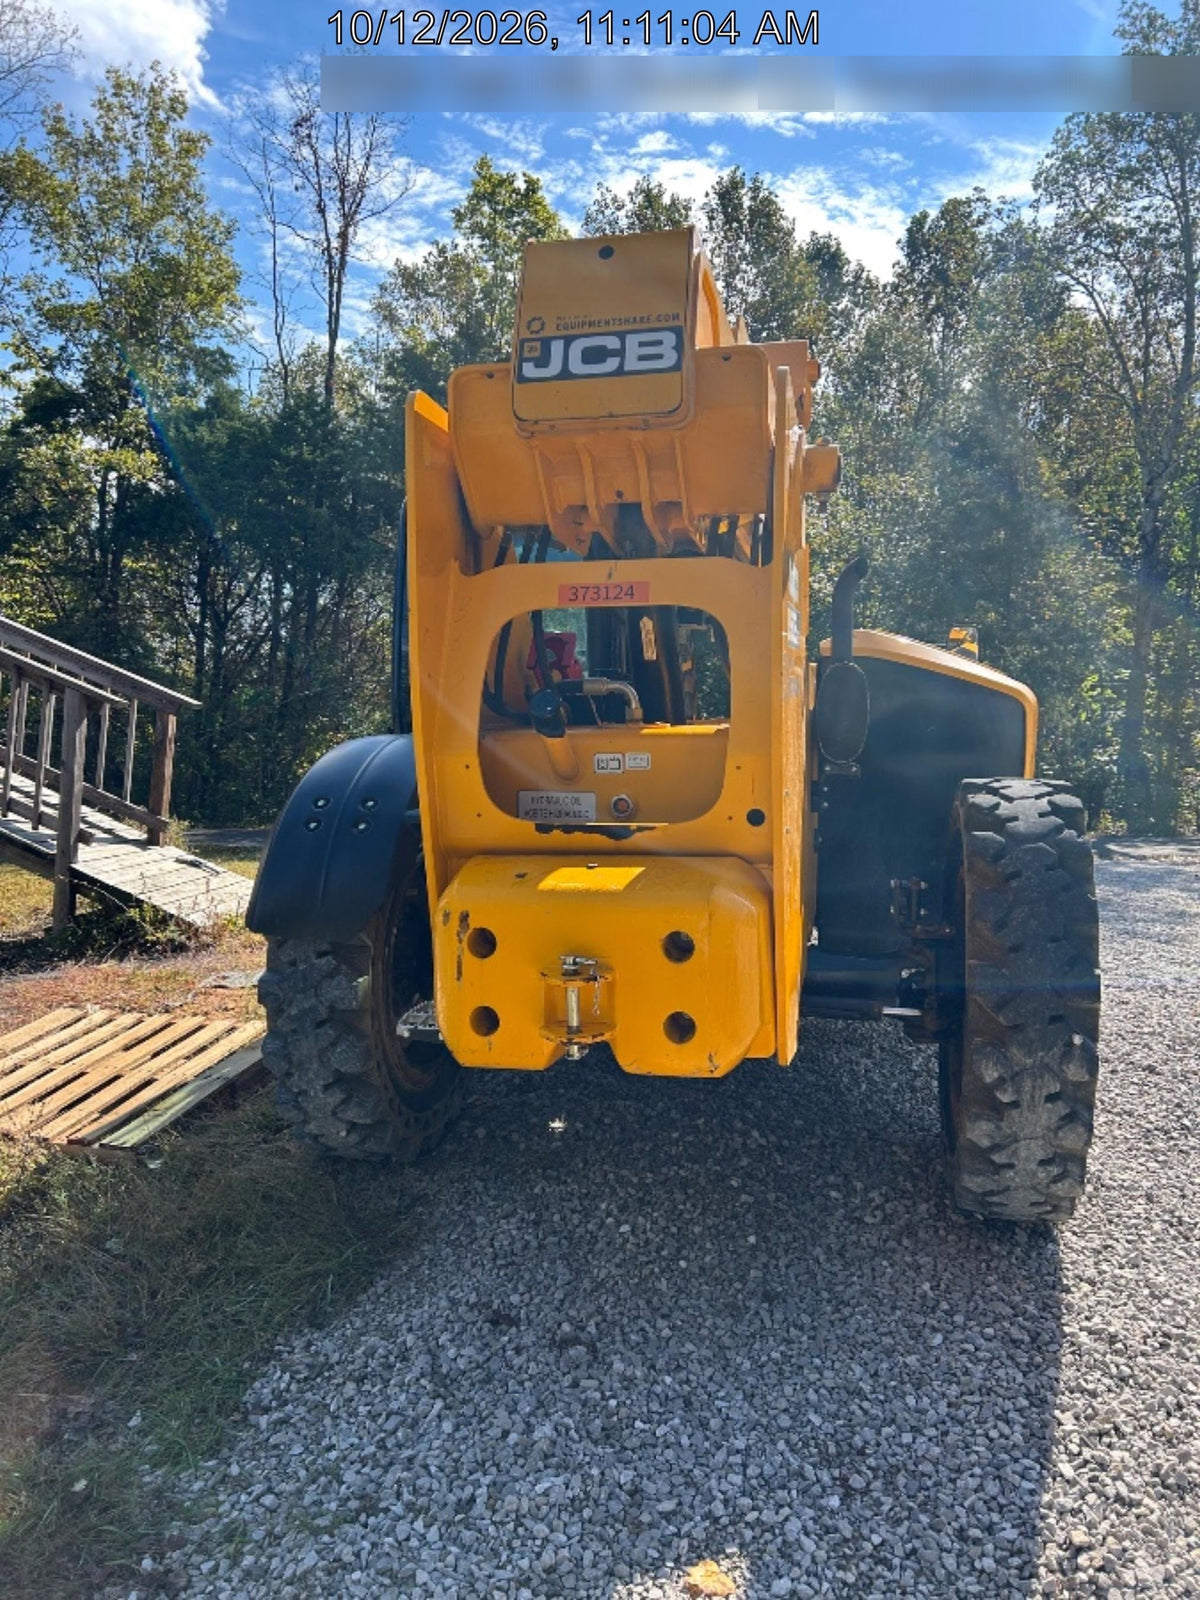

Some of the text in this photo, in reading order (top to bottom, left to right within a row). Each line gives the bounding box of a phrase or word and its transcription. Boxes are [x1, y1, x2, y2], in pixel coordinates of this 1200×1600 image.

[555, 312, 681, 331] EQUIPMENTSHARE.COM
[522, 330, 678, 378] JCB
[568, 584, 635, 601] 373124
